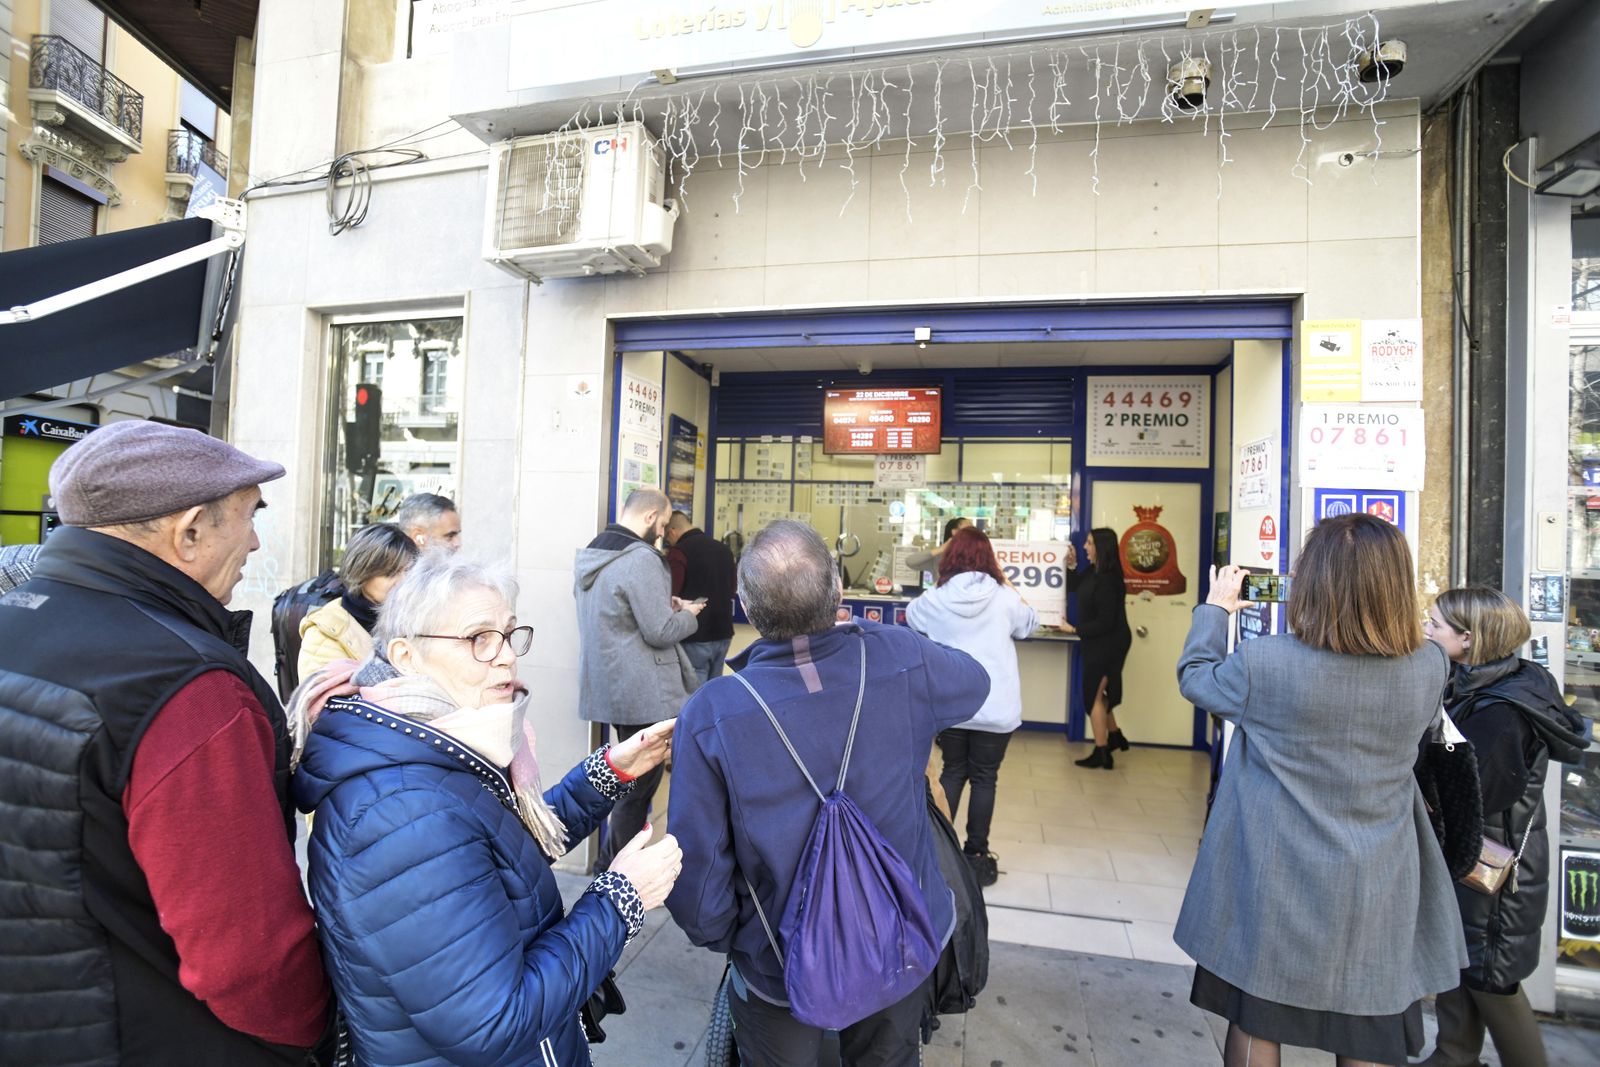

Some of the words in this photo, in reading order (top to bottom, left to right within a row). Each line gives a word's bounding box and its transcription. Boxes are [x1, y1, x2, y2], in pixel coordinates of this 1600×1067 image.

[633, 6, 747, 40] Loterías
[754, 5, 774, 31] y
[1371, 345, 1414, 357] RODYCH
[628, 381, 658, 402] 44469
[1102, 391, 1192, 408] 44469
[629, 398, 634, 409] 2
[634, 400, 656, 416] PREMIO
[1120, 413, 1189, 427] PREMIO
[1323, 413, 1328, 424] 1
[1337, 413, 1400, 426] PREMIO
[1310, 427, 1407, 447] 07861
[879, 461, 920, 470] 07861
[1240, 454, 1268, 475] 07861
[996, 551, 1057, 565] REMIO
[1003, 565, 1064, 589] 296
